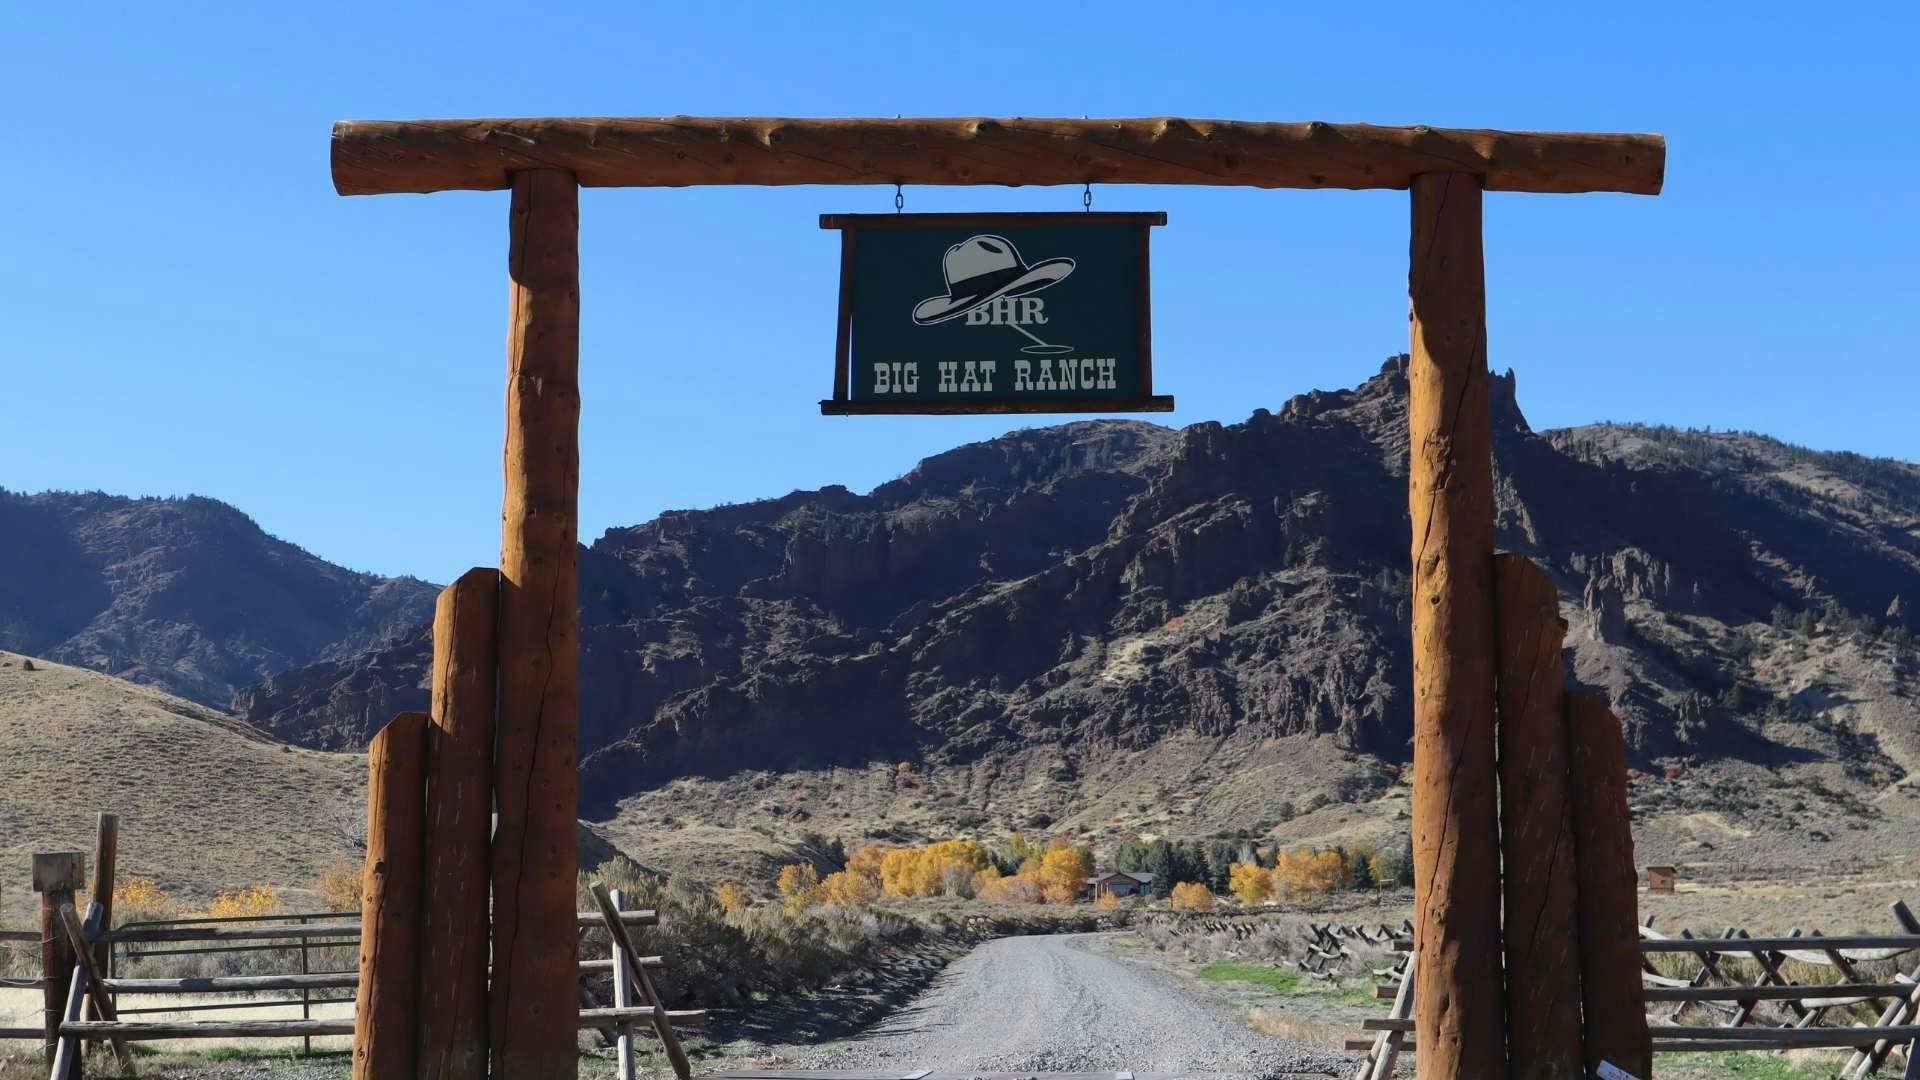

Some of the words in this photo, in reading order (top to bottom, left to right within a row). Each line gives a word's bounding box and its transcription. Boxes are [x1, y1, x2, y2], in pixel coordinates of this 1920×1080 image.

[965, 297, 1049, 326] BHR
[873, 362, 920, 394] BIG
[938, 360, 997, 393] HAT
[1014, 358, 1117, 391] RANCH
